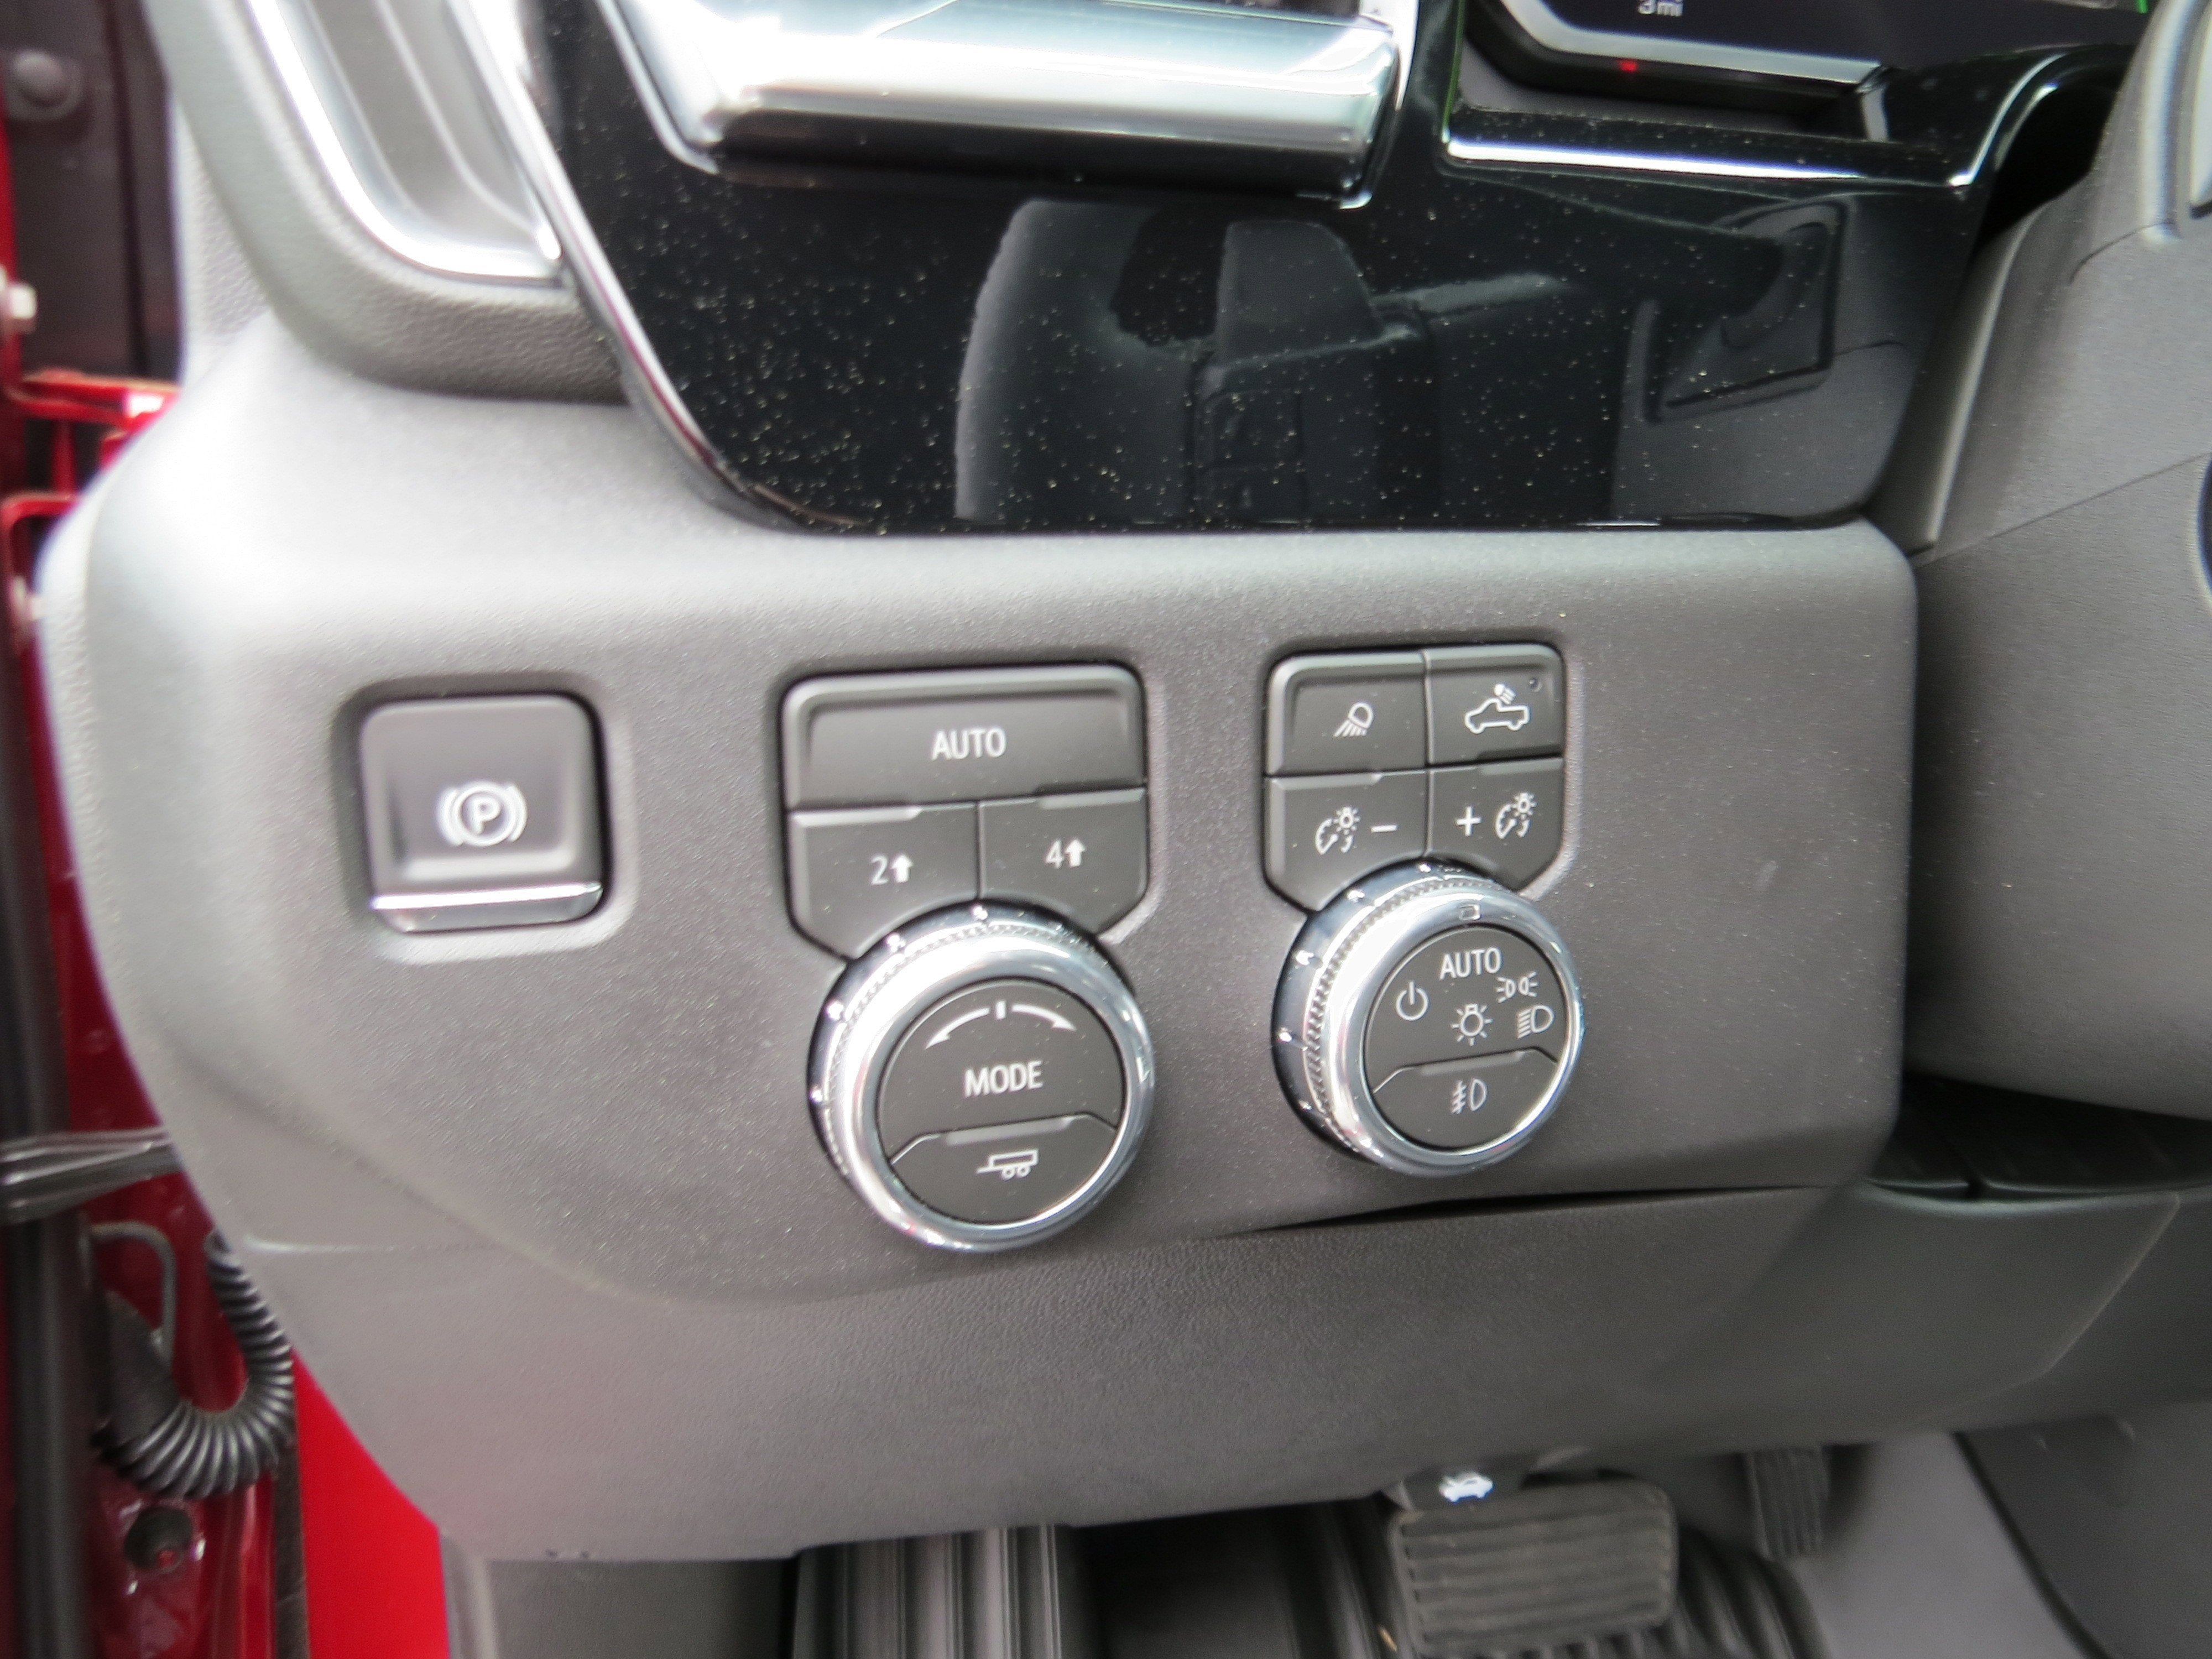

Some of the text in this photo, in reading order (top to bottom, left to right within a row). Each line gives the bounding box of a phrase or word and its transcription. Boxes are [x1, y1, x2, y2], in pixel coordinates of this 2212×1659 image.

[931, 727, 1007, 760] AUTO
[471, 799, 501, 834] P
[870, 856, 889, 885] 2
[1045, 840, 1065, 869] 4
[1439, 946, 1502, 980] AUTO
[964, 1060, 1044, 1098] MODE
